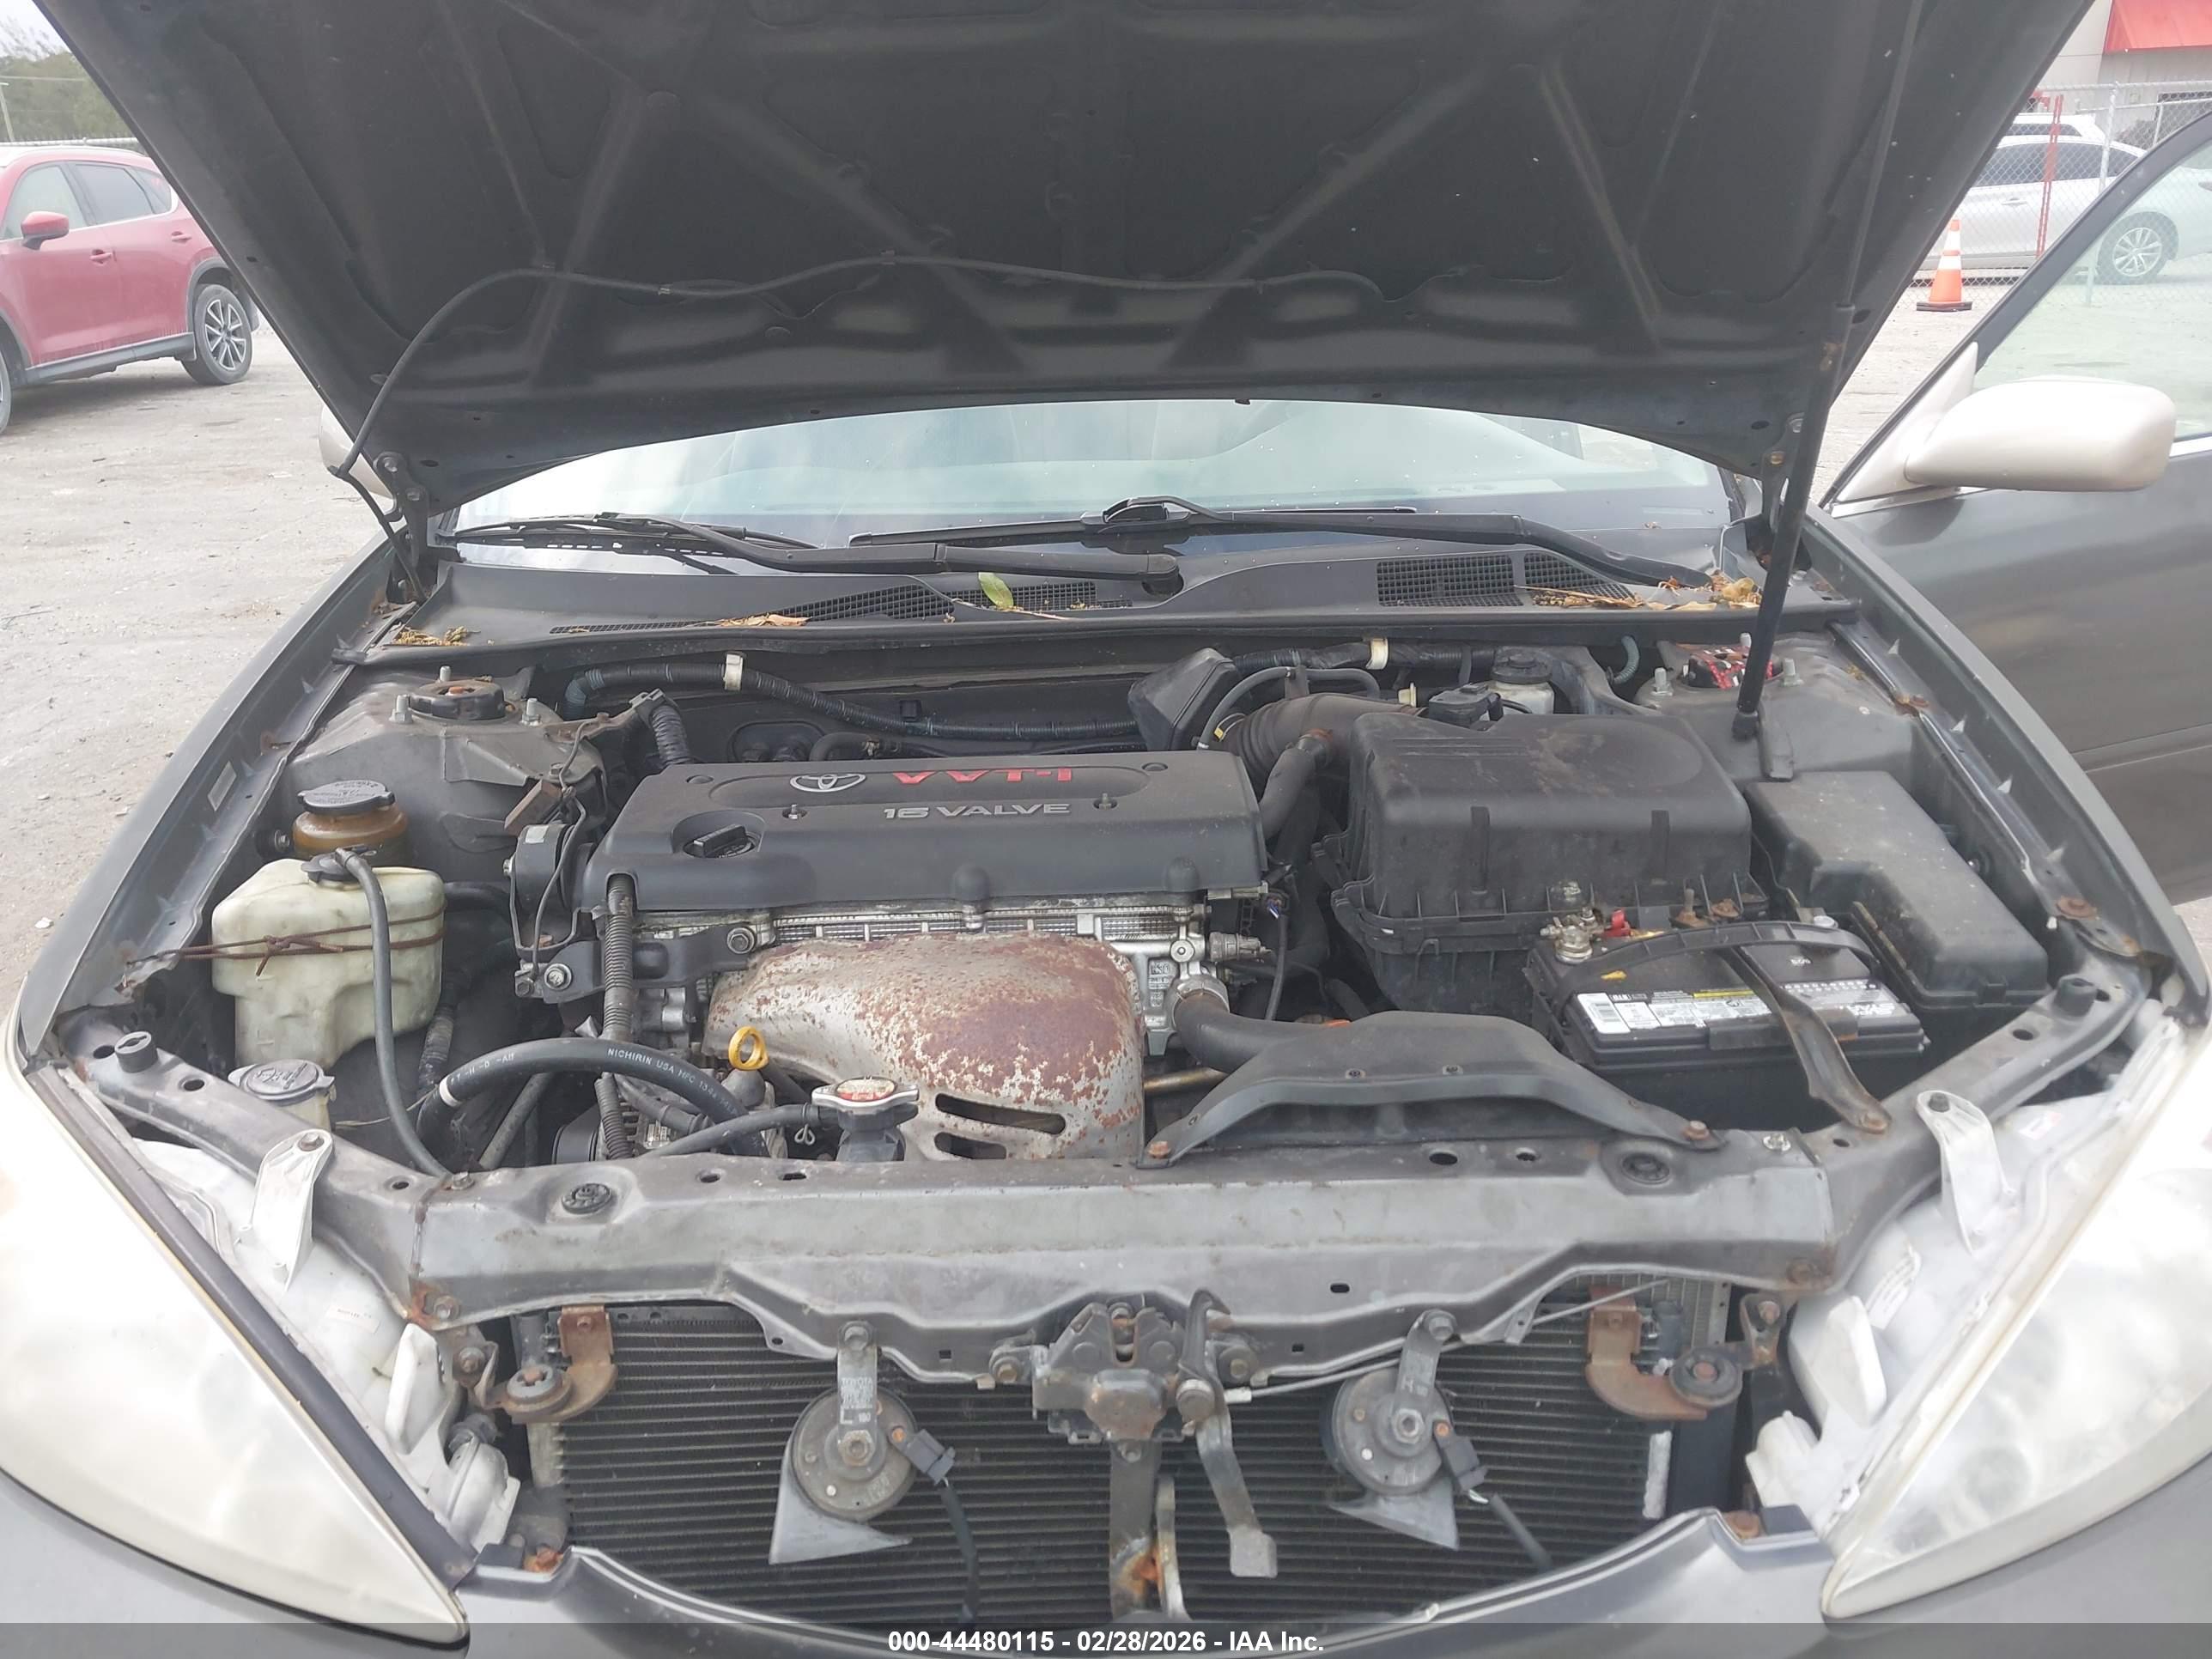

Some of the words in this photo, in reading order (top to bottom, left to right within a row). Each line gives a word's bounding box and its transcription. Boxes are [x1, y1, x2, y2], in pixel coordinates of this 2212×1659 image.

[883, 806, 930, 819] 16
[936, 803, 1072, 817] VALVE
[607, 1048, 653, 1065] NICHIRIN
[656, 1060, 675, 1075] USA
[678, 1069, 696, 1084] HFC
